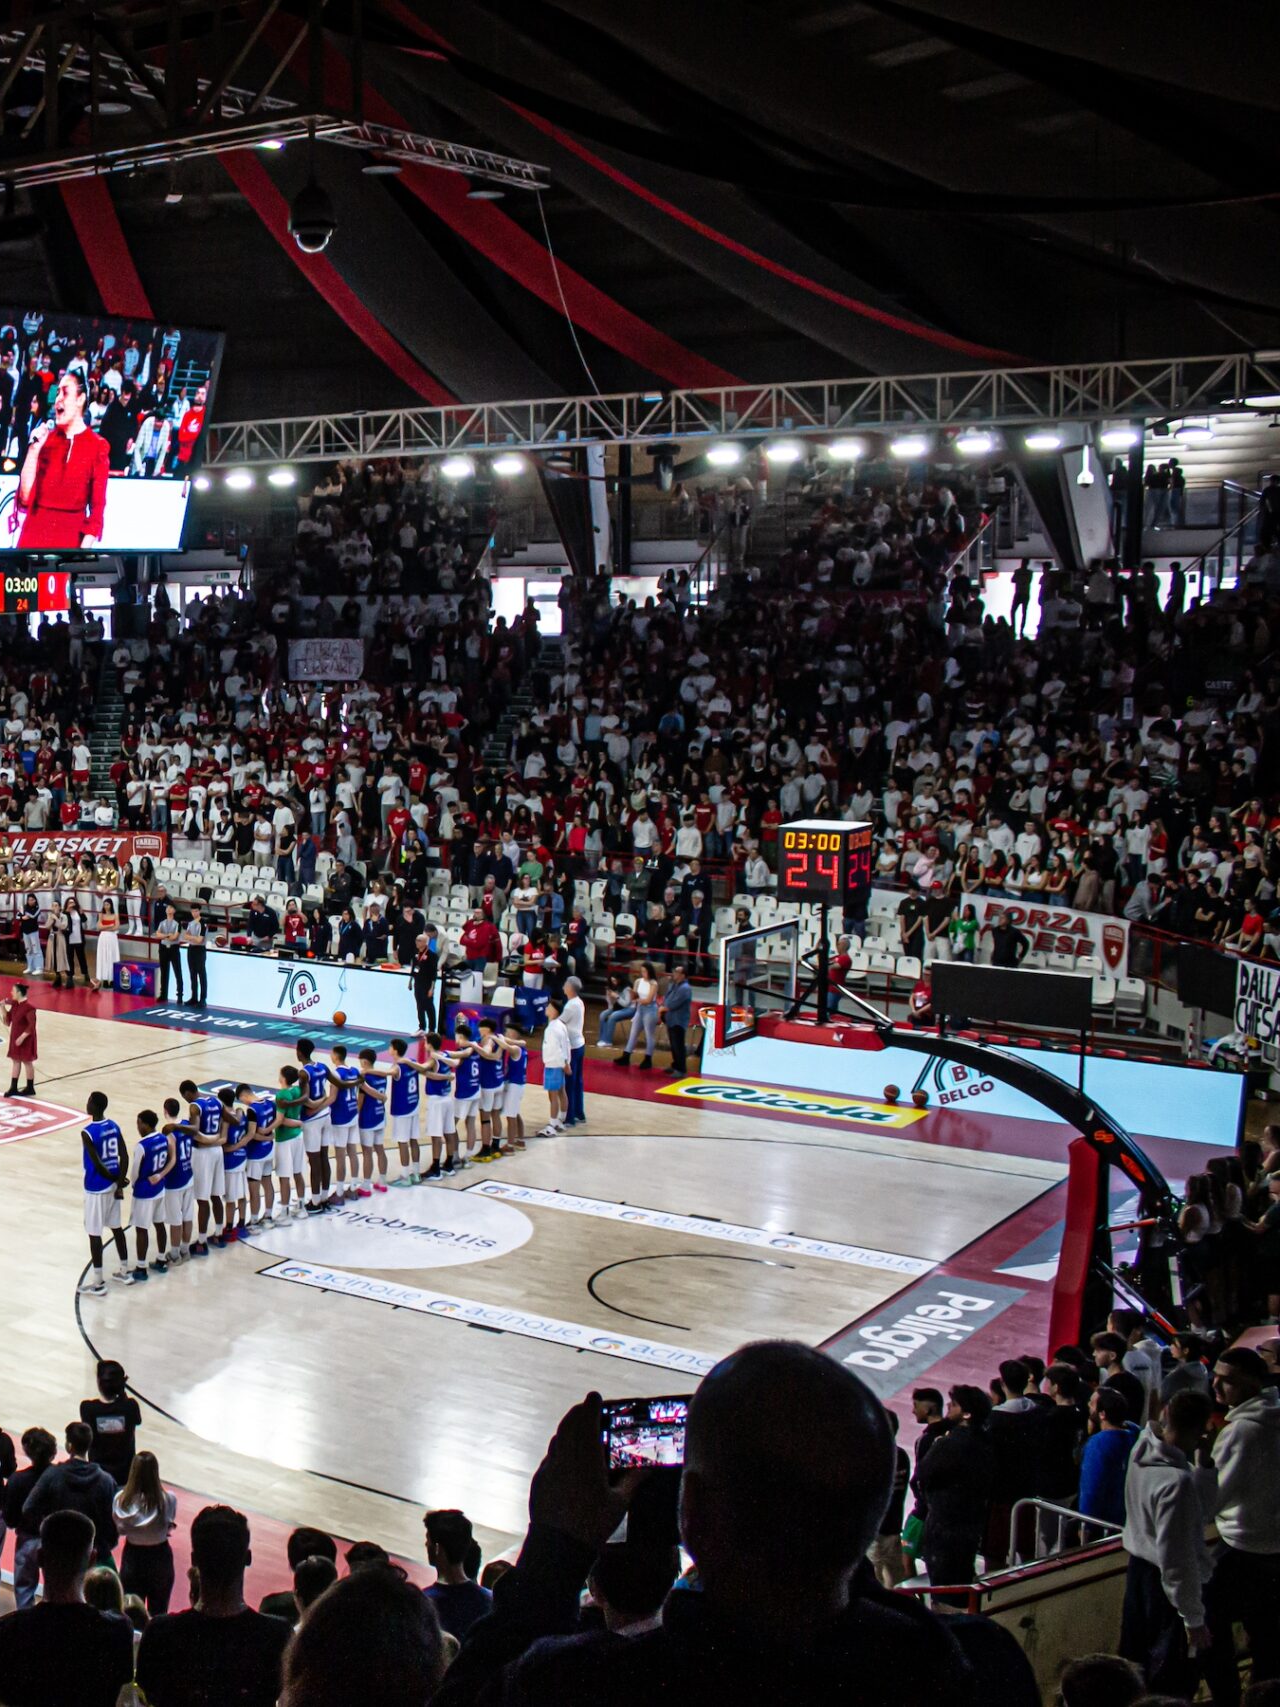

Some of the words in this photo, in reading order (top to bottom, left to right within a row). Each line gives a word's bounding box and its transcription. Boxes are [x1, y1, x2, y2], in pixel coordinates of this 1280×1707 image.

[5, 577, 38, 593] 03:00
[48, 575, 56, 594] 0
[16, 599, 28, 610] 24
[784, 832, 841, 851] 03:00
[785, 852, 839, 890] 24
[848, 851, 871, 888] 24
[984, 902, 1090, 937] FORZA
[277, 966, 317, 1009] 70
[298, 982, 307, 997] B
[291, 993, 321, 1016] BELGO
[146, 1008, 258, 1029] ITELYUM
[471, 1061, 480, 1077] 6
[951, 1065, 968, 1082] B
[408, 1076, 417, 1094] 8
[938, 1080, 995, 1105] BELGO
[683, 1085, 895, 1122] Ricola
[206, 1114, 220, 1133] 15
[101, 1137, 119, 1160] 19
[152, 1150, 168, 1172] 18
[512, 1187, 615, 1213] acinque
[653, 1213, 761, 1241] acinque
[805, 1239, 923, 1271] acinque
[314, 1269, 423, 1303] acinque
[464, 1305, 583, 1339] acinque
[629, 1342, 718, 1370] acinq
[842, 1290, 996, 1372] Pelligra
